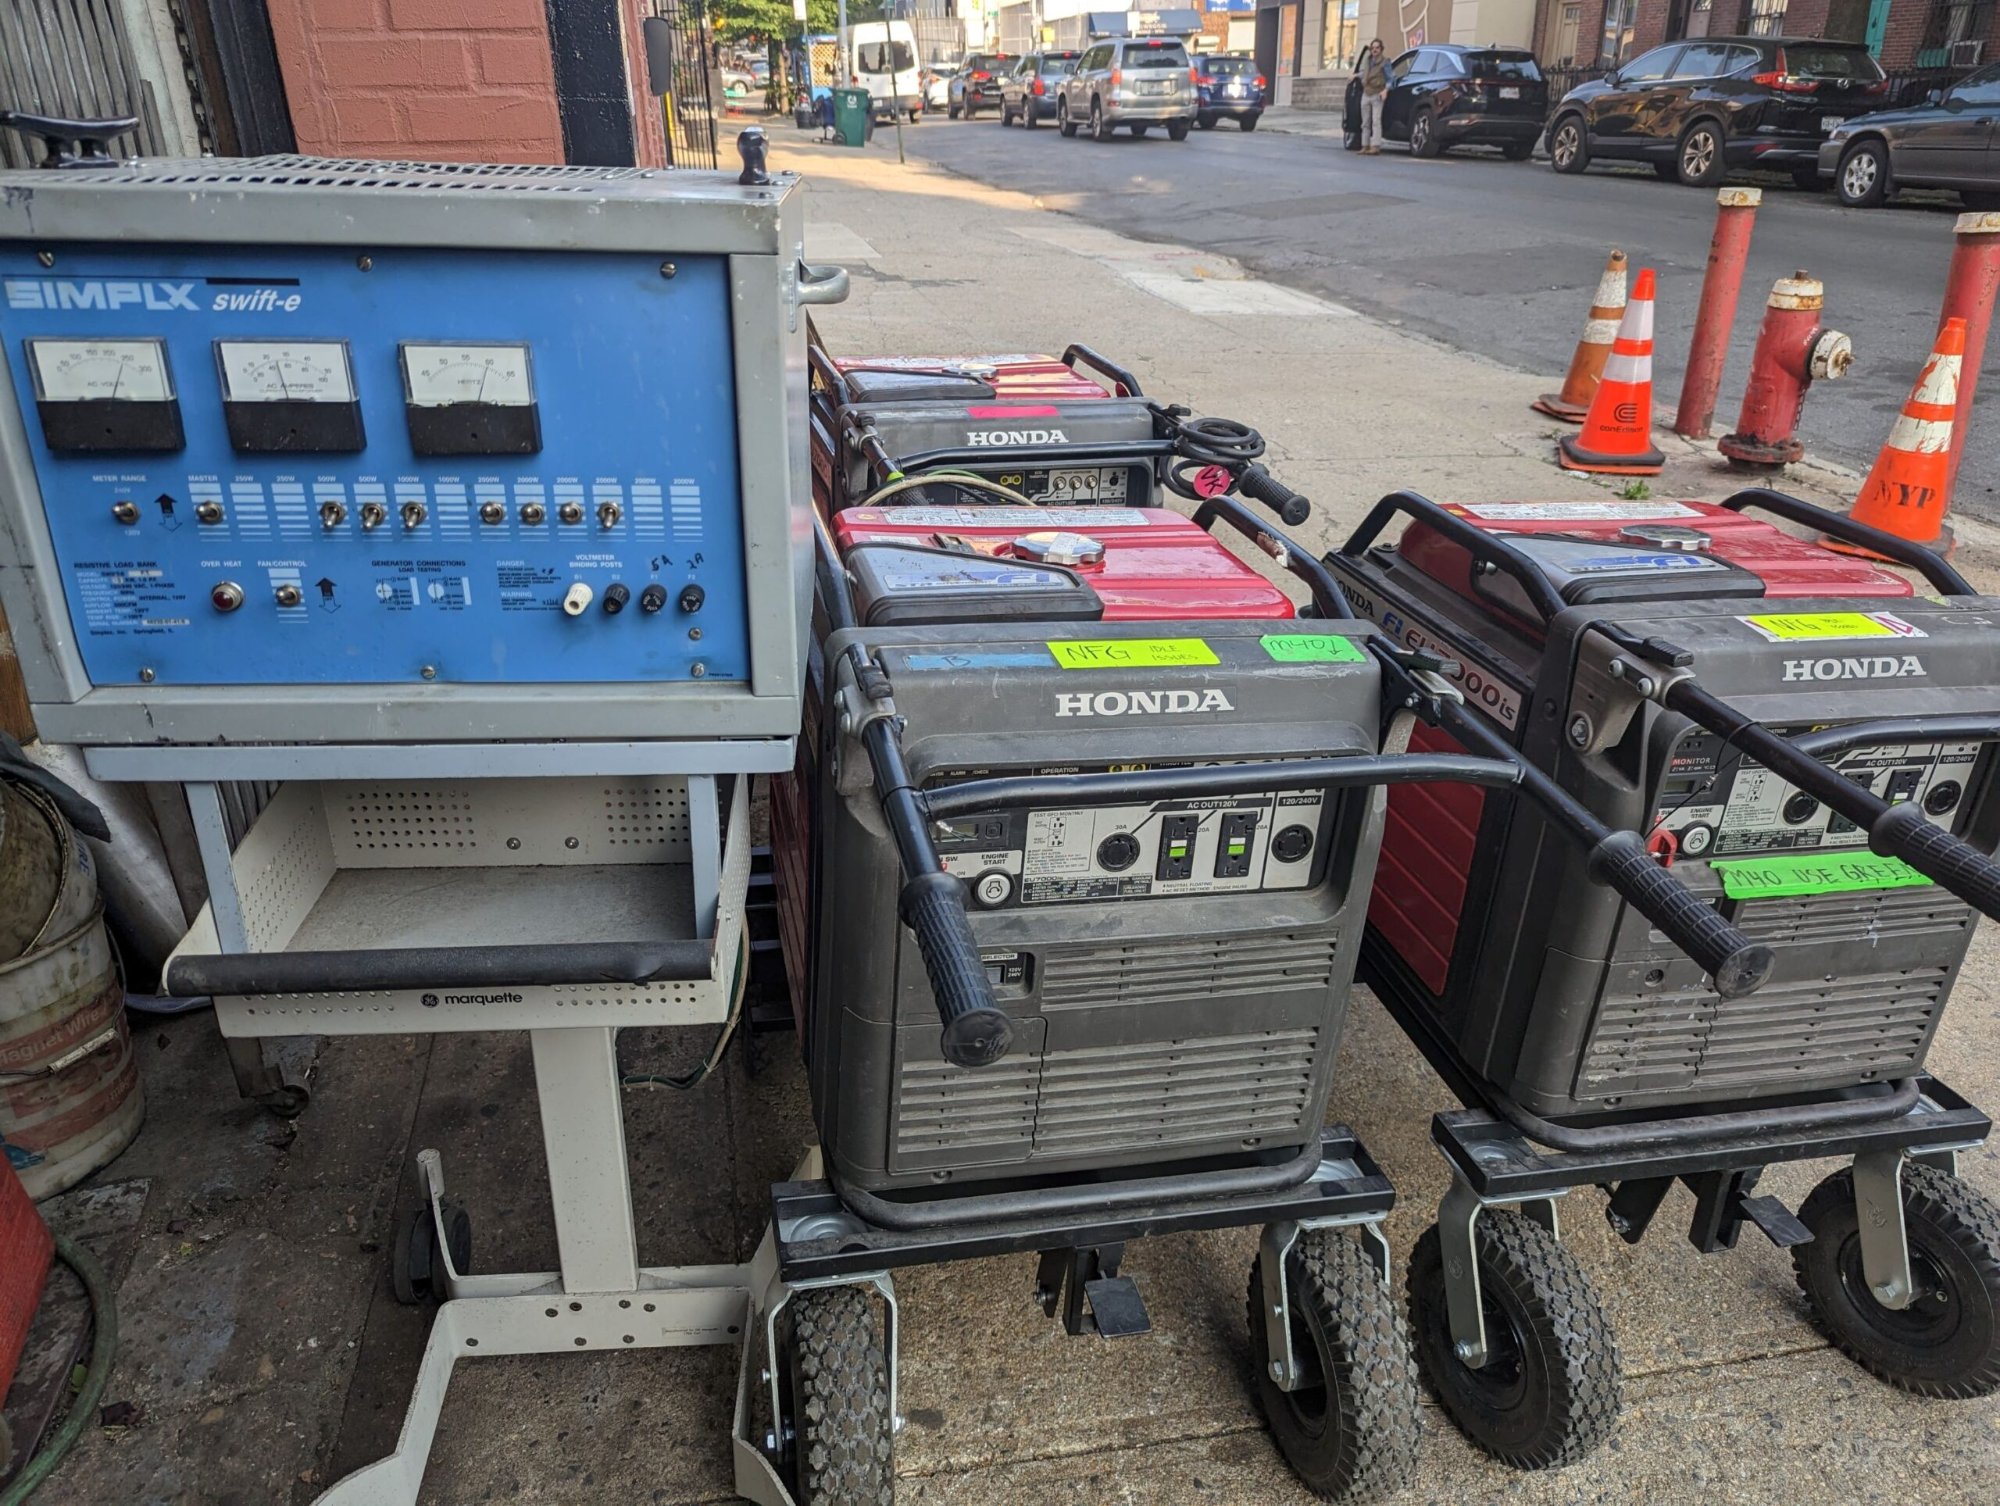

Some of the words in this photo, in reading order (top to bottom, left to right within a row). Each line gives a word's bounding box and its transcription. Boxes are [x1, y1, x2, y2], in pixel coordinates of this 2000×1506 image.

[4, 281, 200, 311] SIMPLX
[212, 289, 301, 312] swift-e
[967, 429, 1068, 446] HONDA
[1066, 645, 1130, 662] NFG
[1150, 645, 1178, 653] IDLE
[1782, 656, 1926, 681] HONDA
[1055, 689, 1235, 718] HONDA
[1200, 800, 1238, 808] OUT120V
[1792, 868, 1838, 885] USE
[445, 992, 522, 1006] marquette
